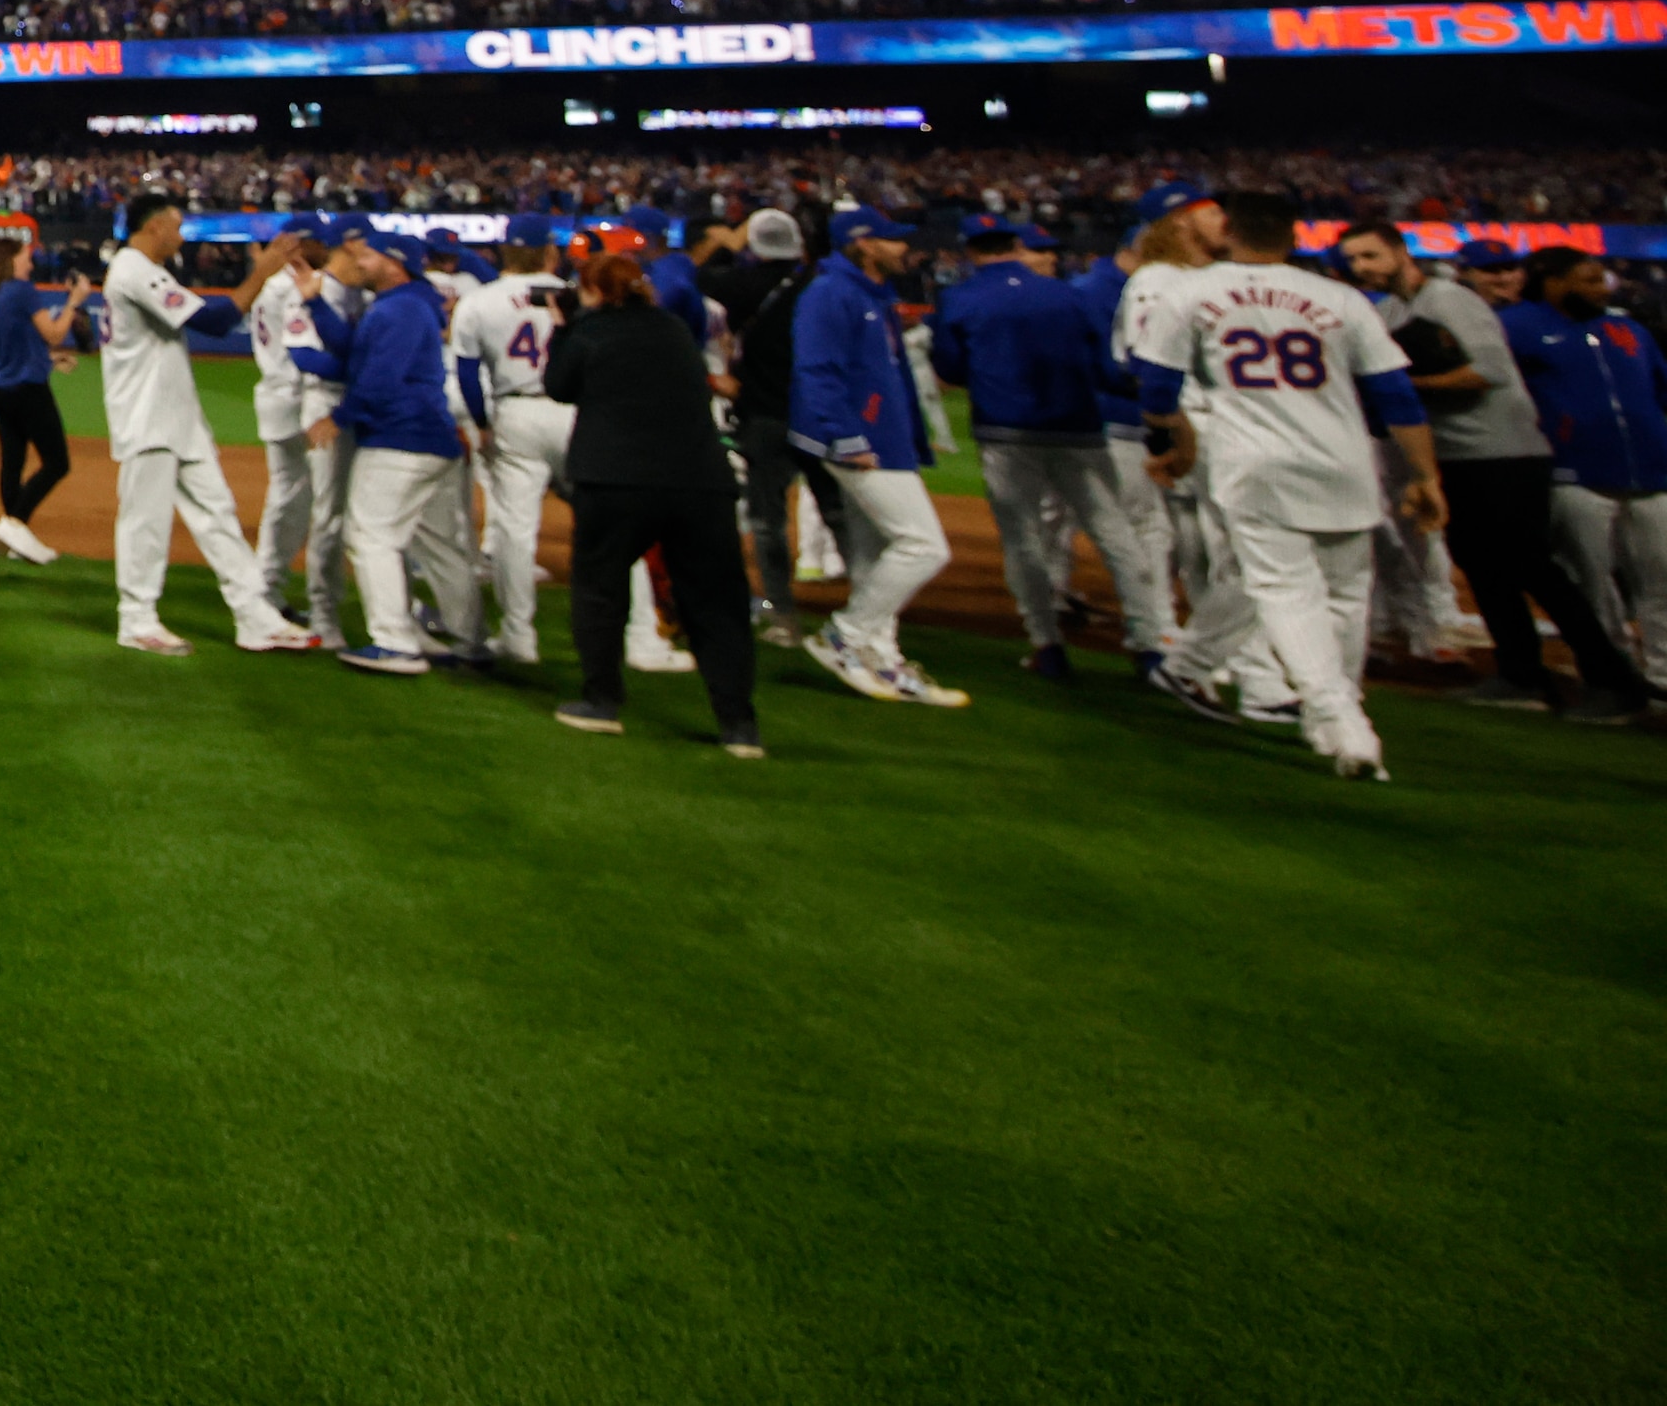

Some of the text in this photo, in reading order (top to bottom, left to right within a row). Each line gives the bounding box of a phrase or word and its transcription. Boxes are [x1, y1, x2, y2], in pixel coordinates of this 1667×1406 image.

[466, 23, 815, 69] CLINCHED!
[1269, 2, 1521, 50] METS
[8, 40, 123, 75] WIN!
[1221, 328, 1326, 389] 28
